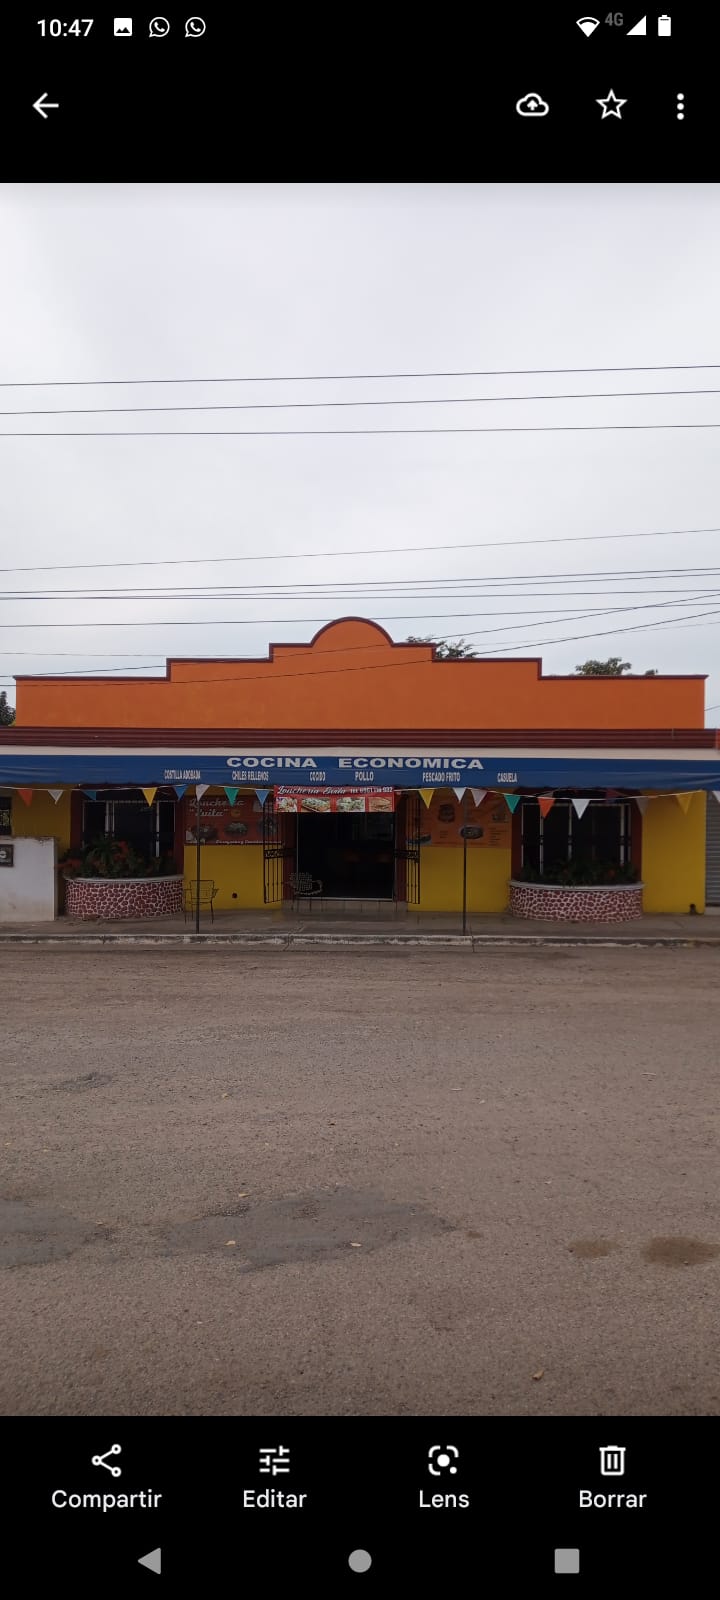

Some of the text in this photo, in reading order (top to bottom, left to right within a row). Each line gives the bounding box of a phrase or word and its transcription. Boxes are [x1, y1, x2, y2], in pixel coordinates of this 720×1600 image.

[226, 757, 485, 770] COCINA ECONOMICA
[231, 770, 269, 782] CHILES RELLENOS
[354, 771, 374, 782] POLLO
[422, 772, 461, 782] PESCADO FRITO
[497, 772, 518, 783] CASUELA
